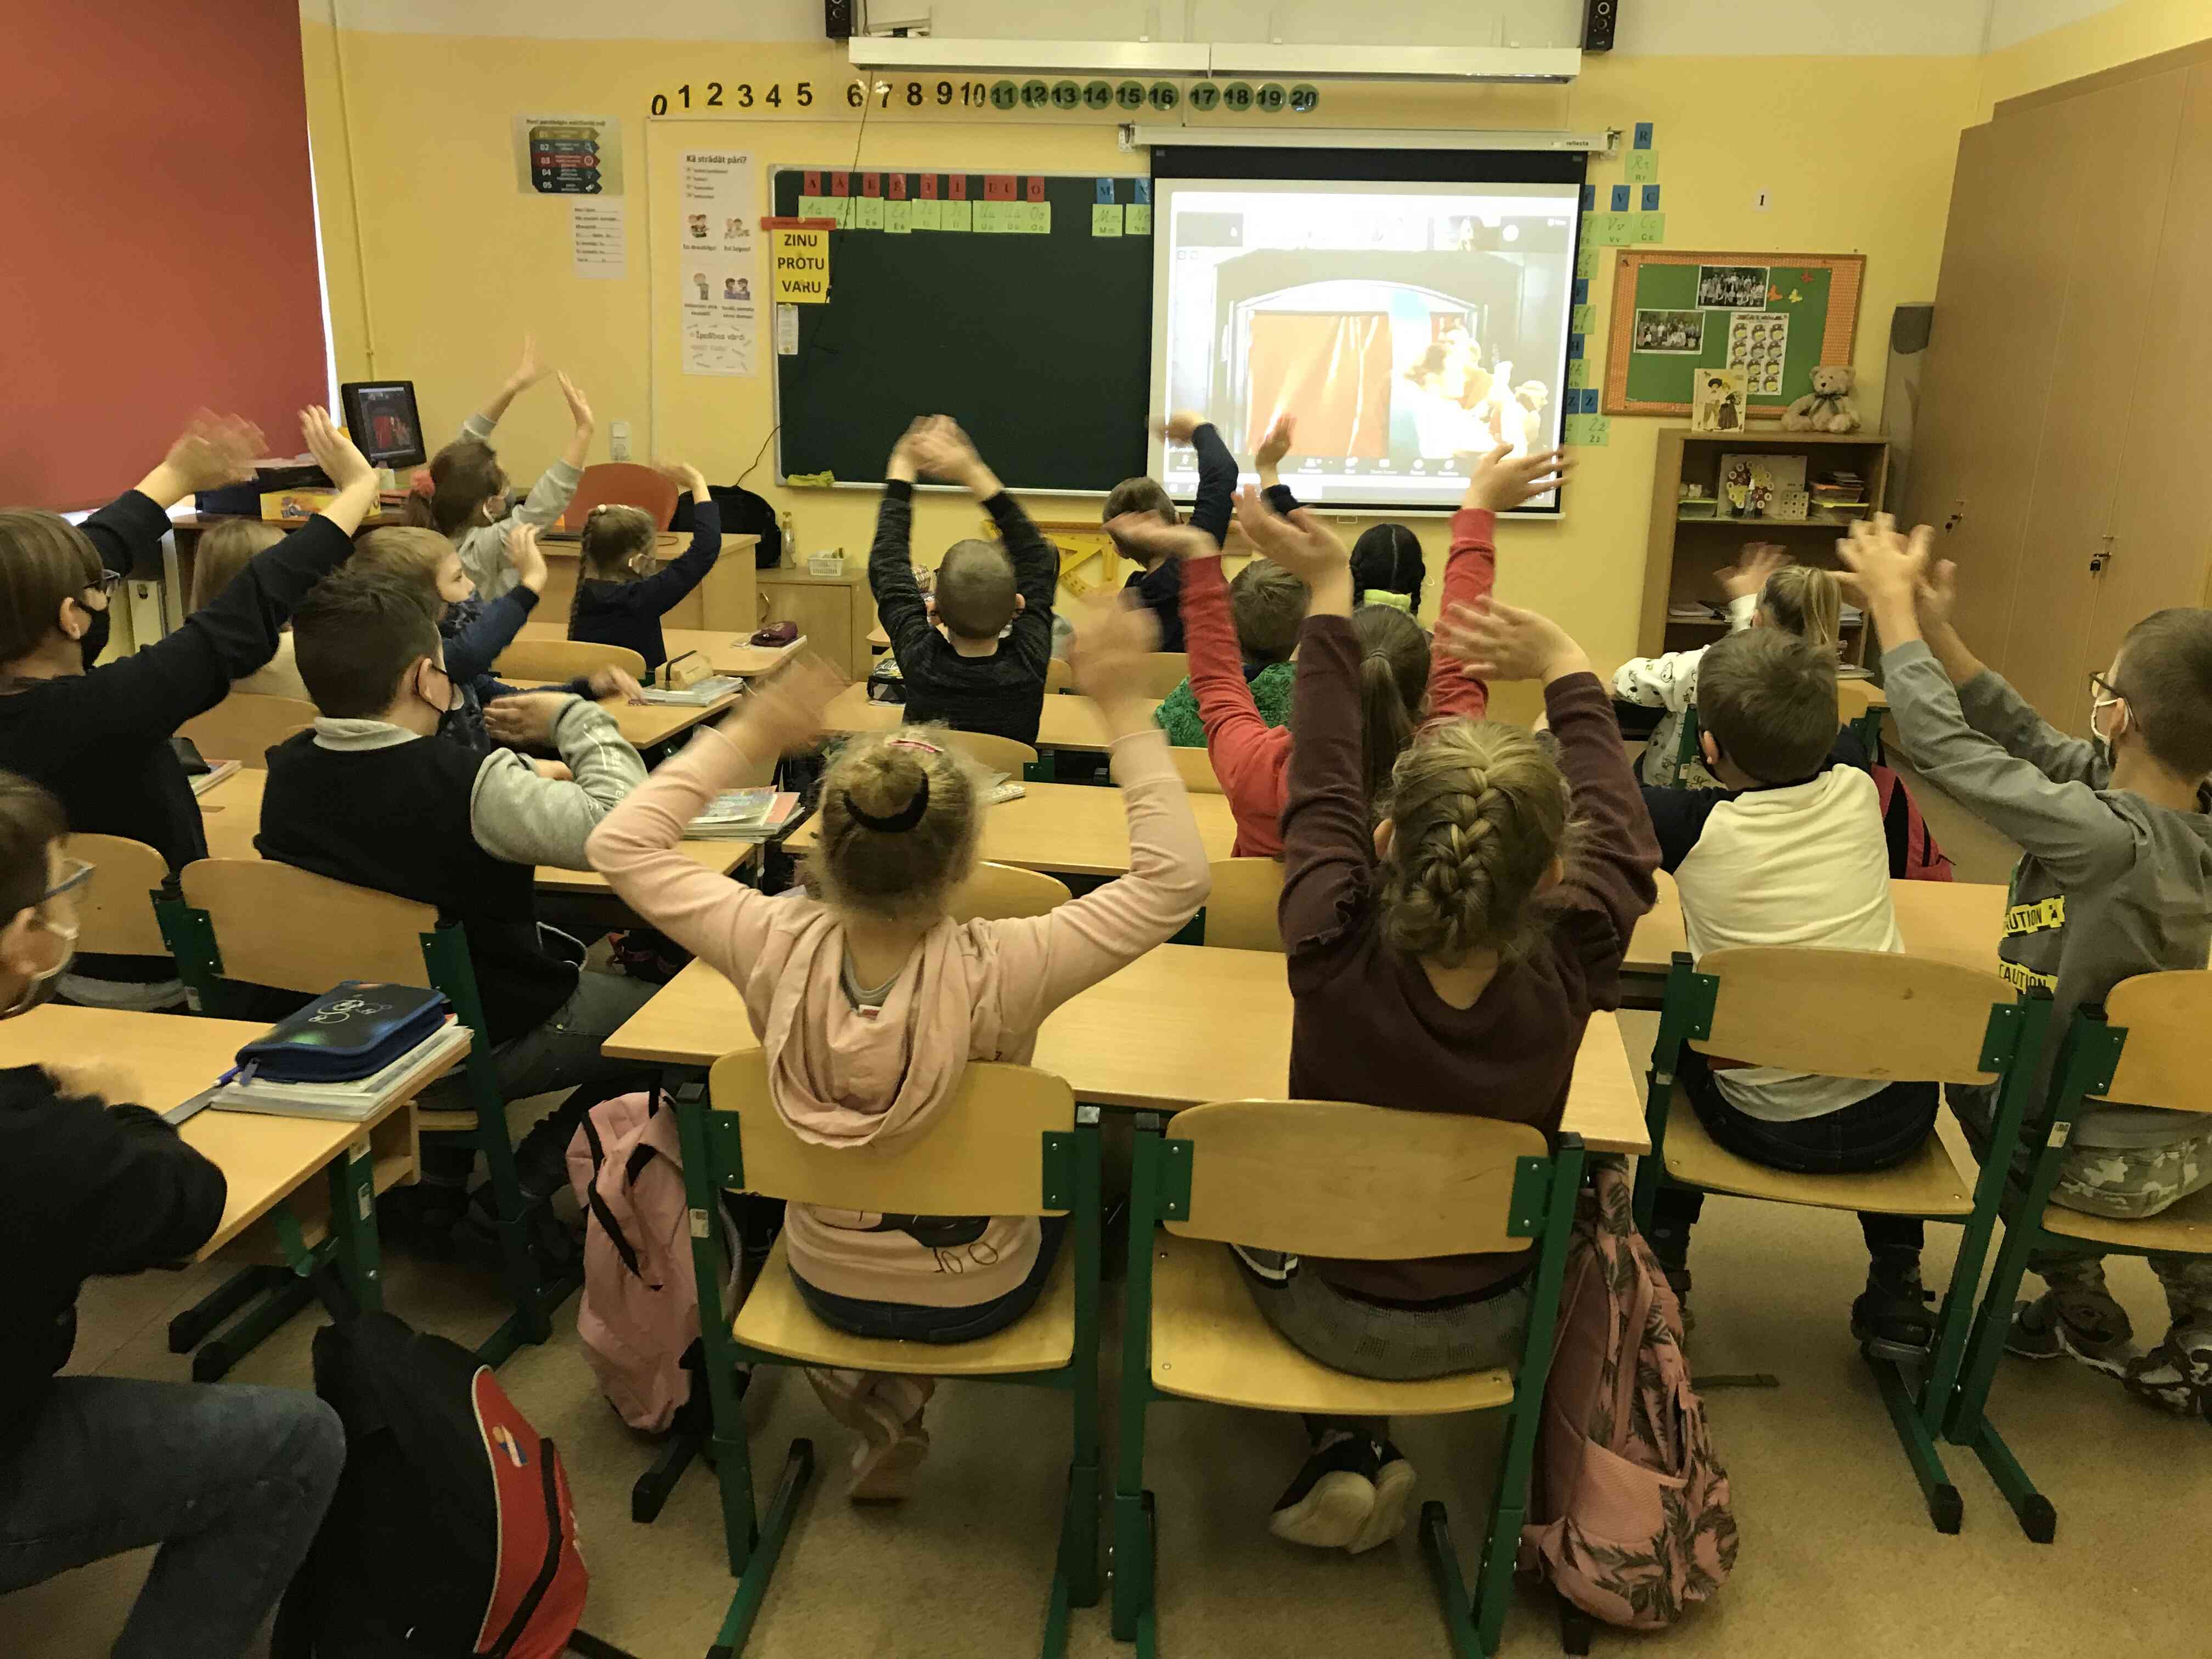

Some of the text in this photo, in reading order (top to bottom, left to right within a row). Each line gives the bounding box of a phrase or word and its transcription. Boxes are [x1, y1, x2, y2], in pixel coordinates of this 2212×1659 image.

[651, 81, 1317, 116] 0 1 2 3 4 5 6 7 8 9 10 11 12 13 14 15 16 17 18 19 20
[1031, 184, 1041, 195] O
[1646, 193, 1655, 202] C
[784, 234, 817, 246] ZINU
[777, 257, 825, 270] PROTU
[782, 280, 821, 293] VARU
[1999, 964, 2046, 990] CAUTION
